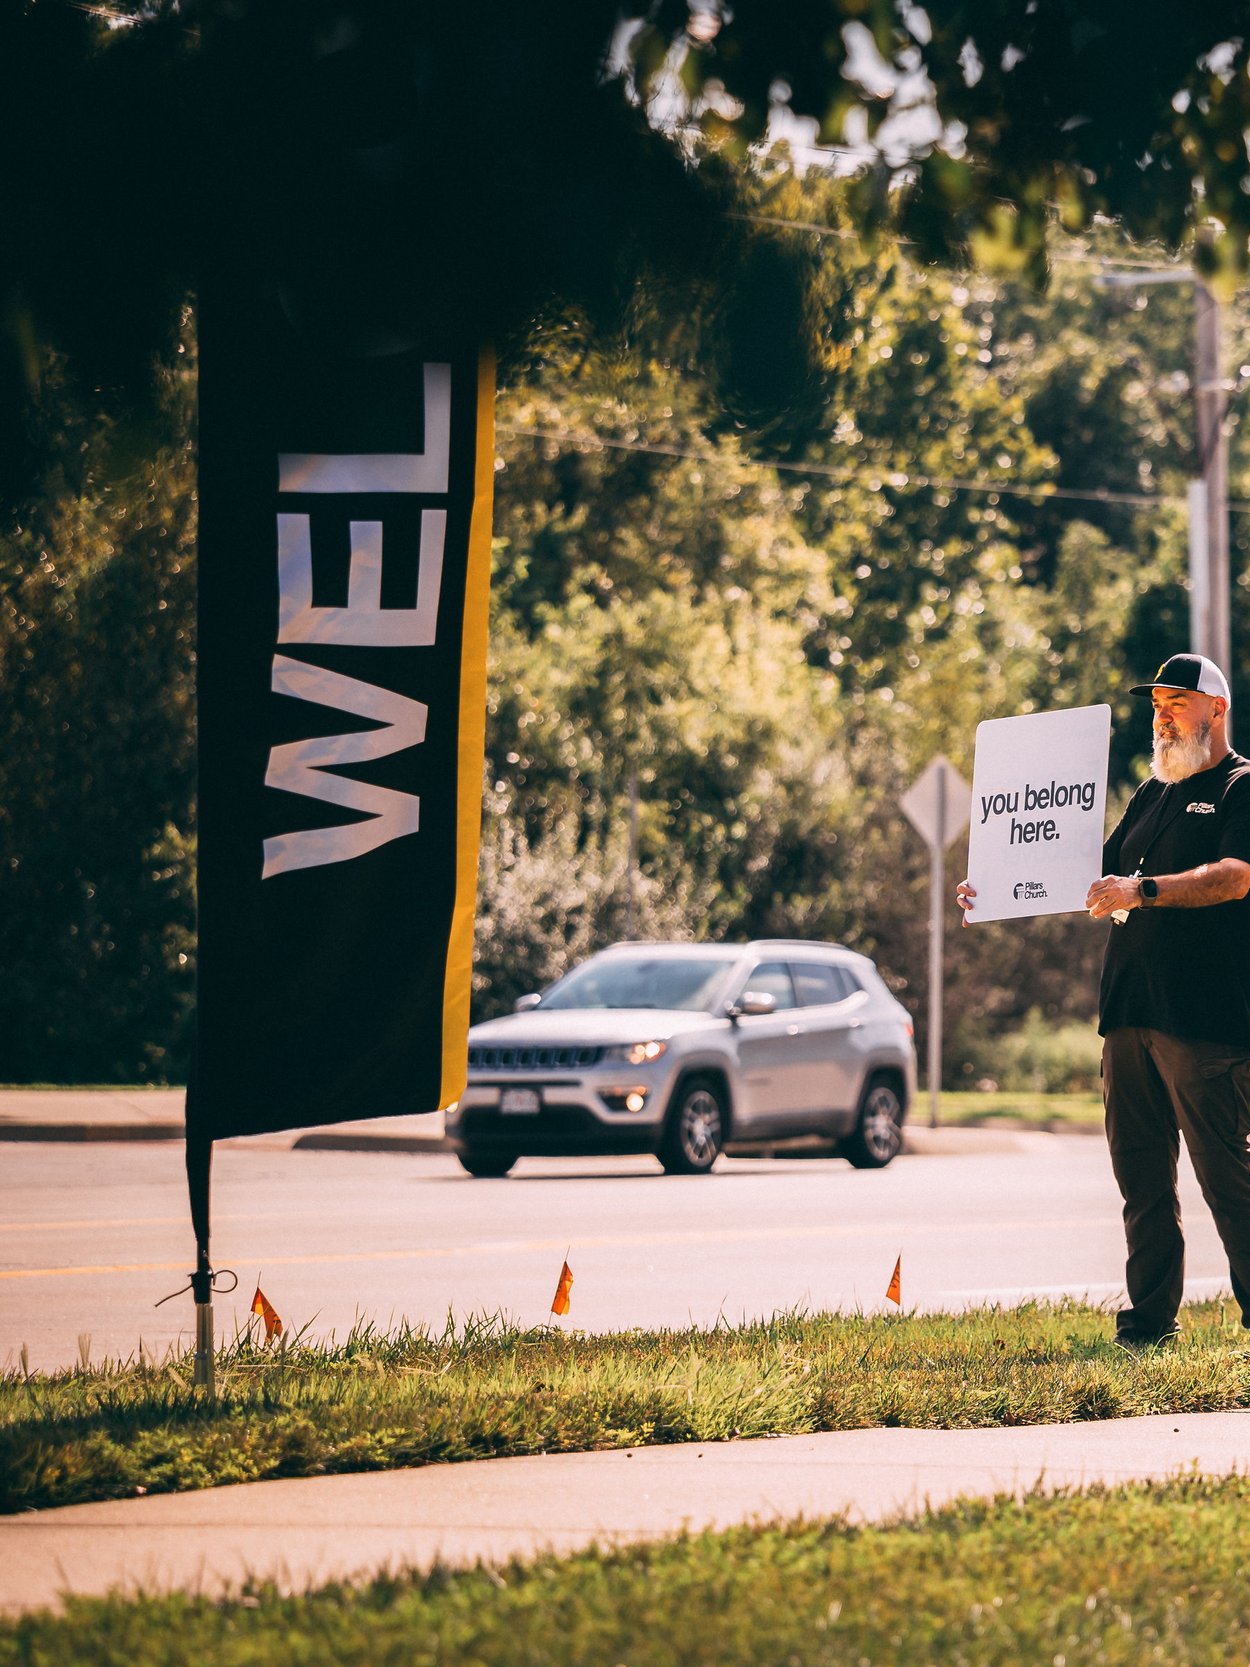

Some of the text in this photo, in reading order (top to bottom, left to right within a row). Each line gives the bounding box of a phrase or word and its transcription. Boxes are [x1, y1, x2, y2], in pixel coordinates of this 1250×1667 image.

[981, 780, 1096, 824] you belong
[1010, 817, 1060, 845] here.
[1025, 881, 1044, 890] Pillars
